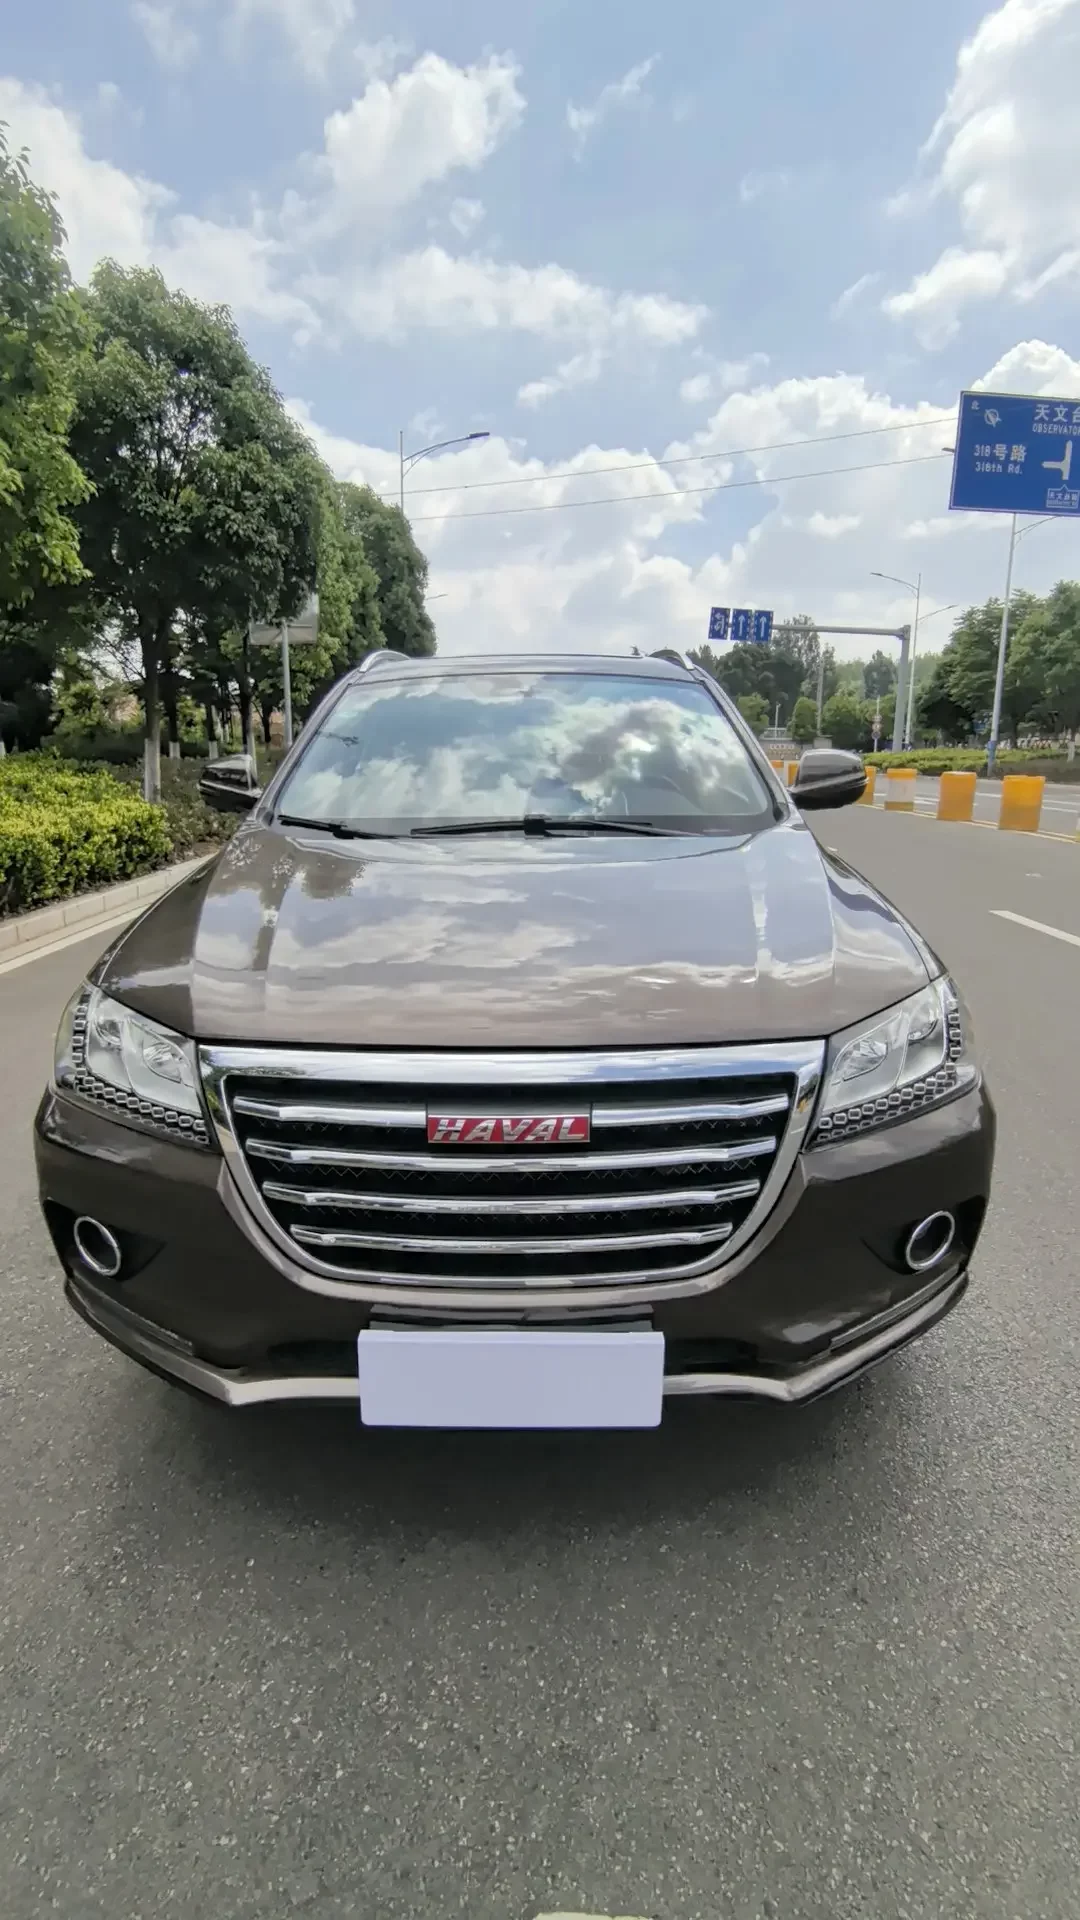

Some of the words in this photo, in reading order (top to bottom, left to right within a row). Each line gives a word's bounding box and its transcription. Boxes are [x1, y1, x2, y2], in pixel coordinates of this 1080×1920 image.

[974, 443, 1027, 462] 318号路
[975, 461, 1003, 473] 318th
[1007, 463, 1023, 475] Rd.
[432, 1118, 585, 1142] HAVAL
